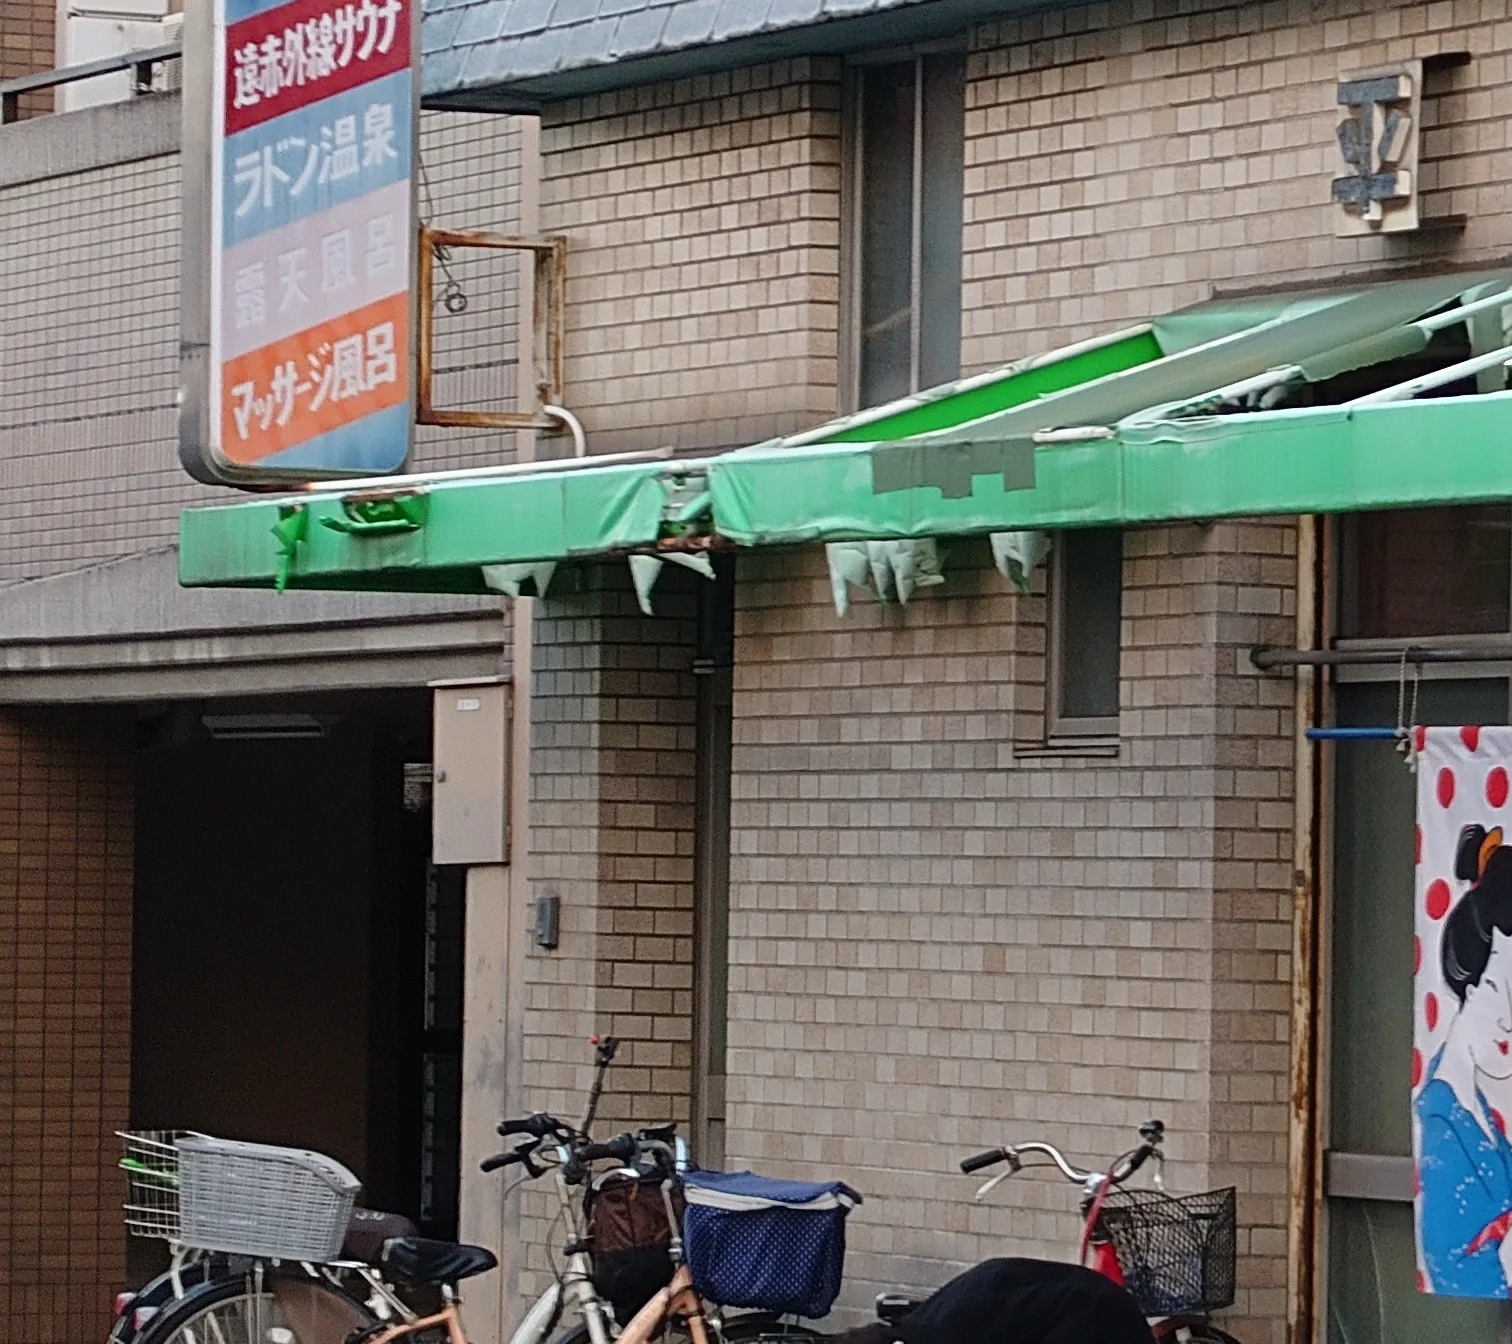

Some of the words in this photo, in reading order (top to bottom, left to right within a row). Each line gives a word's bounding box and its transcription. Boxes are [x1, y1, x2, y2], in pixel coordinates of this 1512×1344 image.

[234, 102, 399, 219] ラドン温泉
[234, 214, 397, 330] 露天風呂
[231, 321, 397, 441] マッサージ風呂
